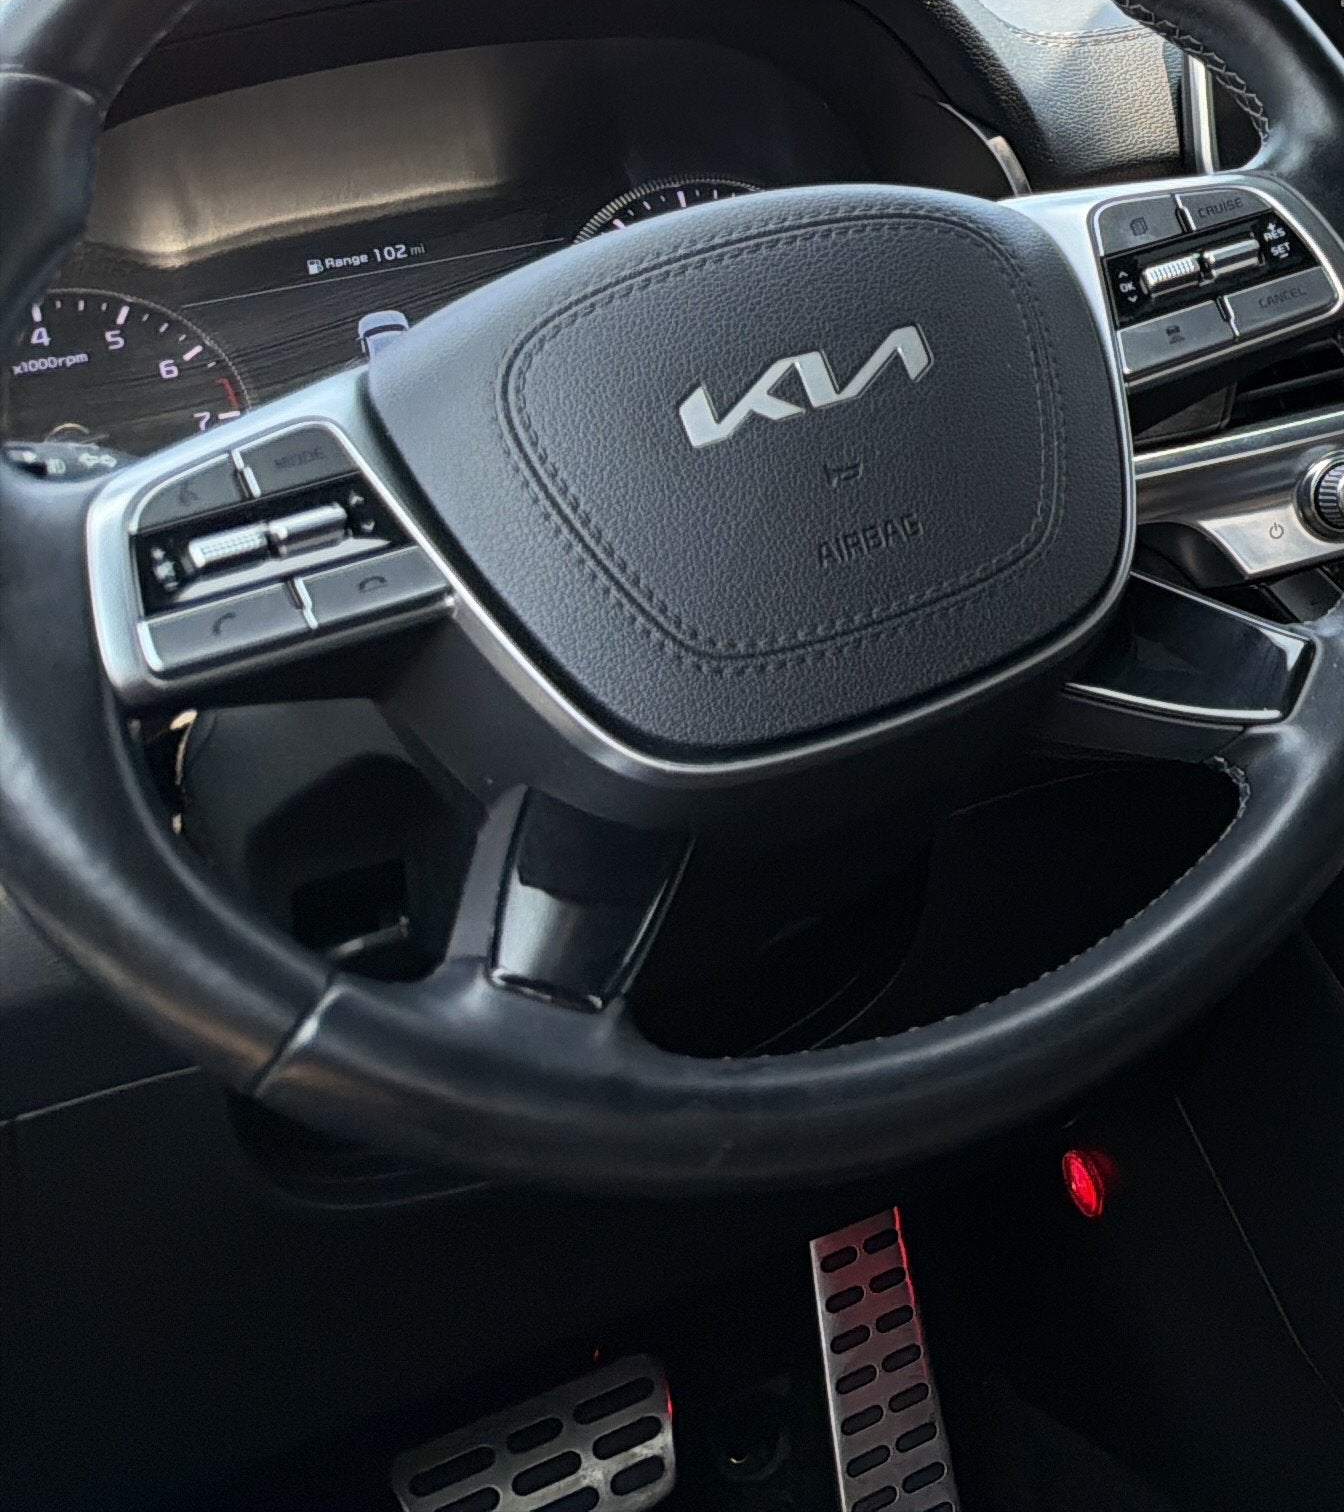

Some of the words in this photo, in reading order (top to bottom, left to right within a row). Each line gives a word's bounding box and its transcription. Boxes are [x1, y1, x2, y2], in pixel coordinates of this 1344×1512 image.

[1197, 197, 1244, 219] CRUISE
[1263, 228, 1286, 242] RES
[324, 254, 369, 270] Range
[373, 244, 408, 263] 102
[410, 243, 425, 256] mi
[1271, 241, 1291, 255] SET
[1258, 288, 1307, 309] CANCEL
[31, 327, 51, 347] 4
[105, 330, 125, 350] 5
[12, 352, 89, 376] x1000rpm
[159, 360, 179, 379] 6
[193, 412, 211, 431] 7
[819, 513, 925, 568] AIRBAG
